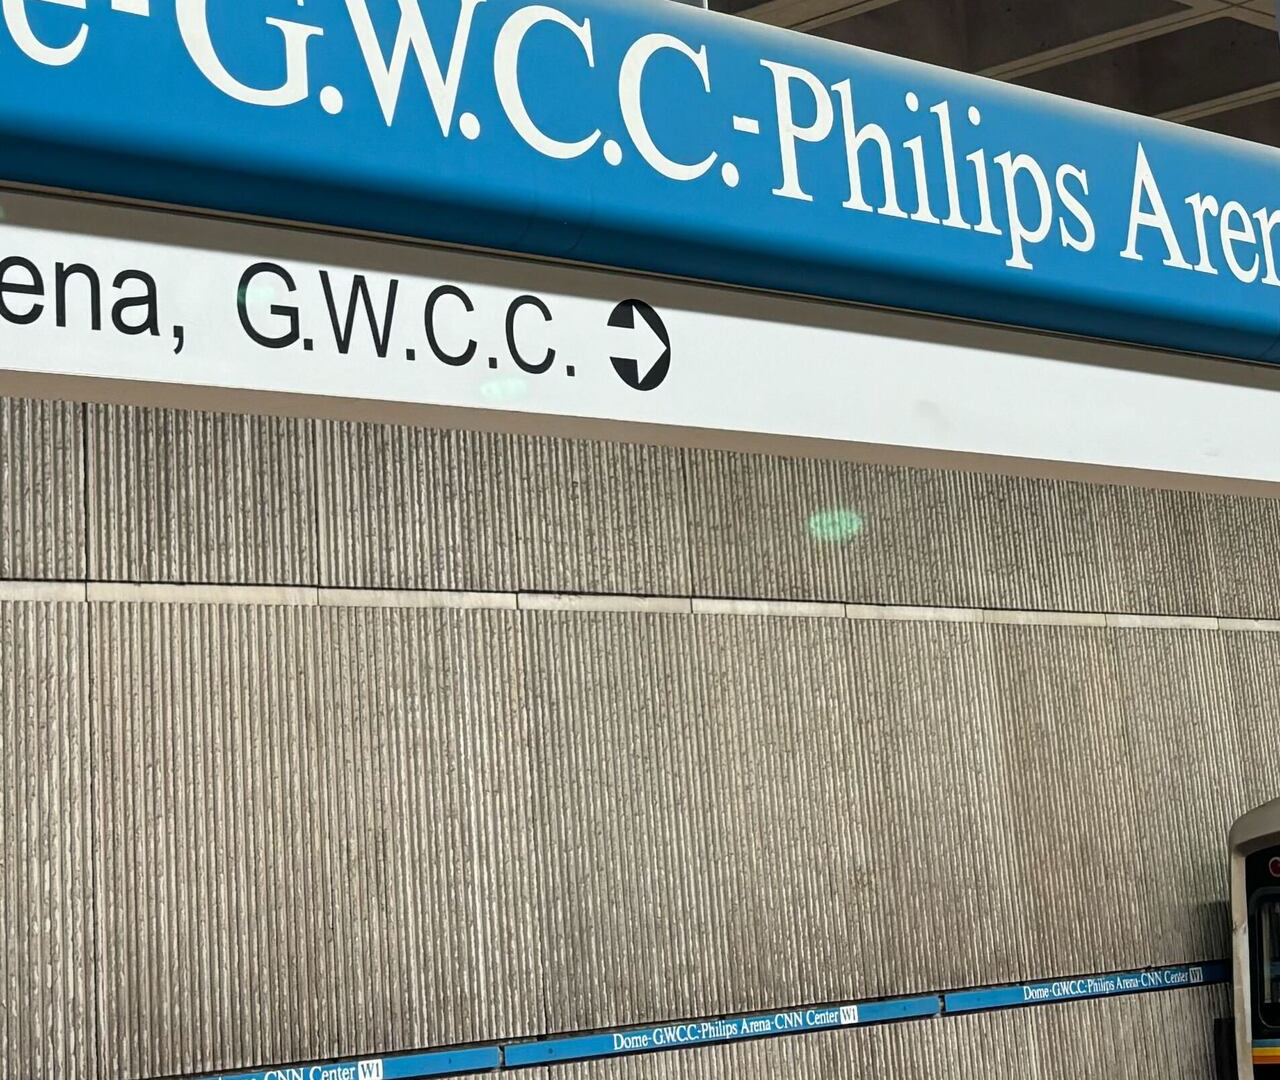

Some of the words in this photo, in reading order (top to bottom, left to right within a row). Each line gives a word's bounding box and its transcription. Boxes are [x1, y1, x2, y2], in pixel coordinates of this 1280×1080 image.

[237, 261, 576, 377] G.W.C.C.
[806, 1009, 839, 1025] Center
[360, 1062, 380, 1079] W1
